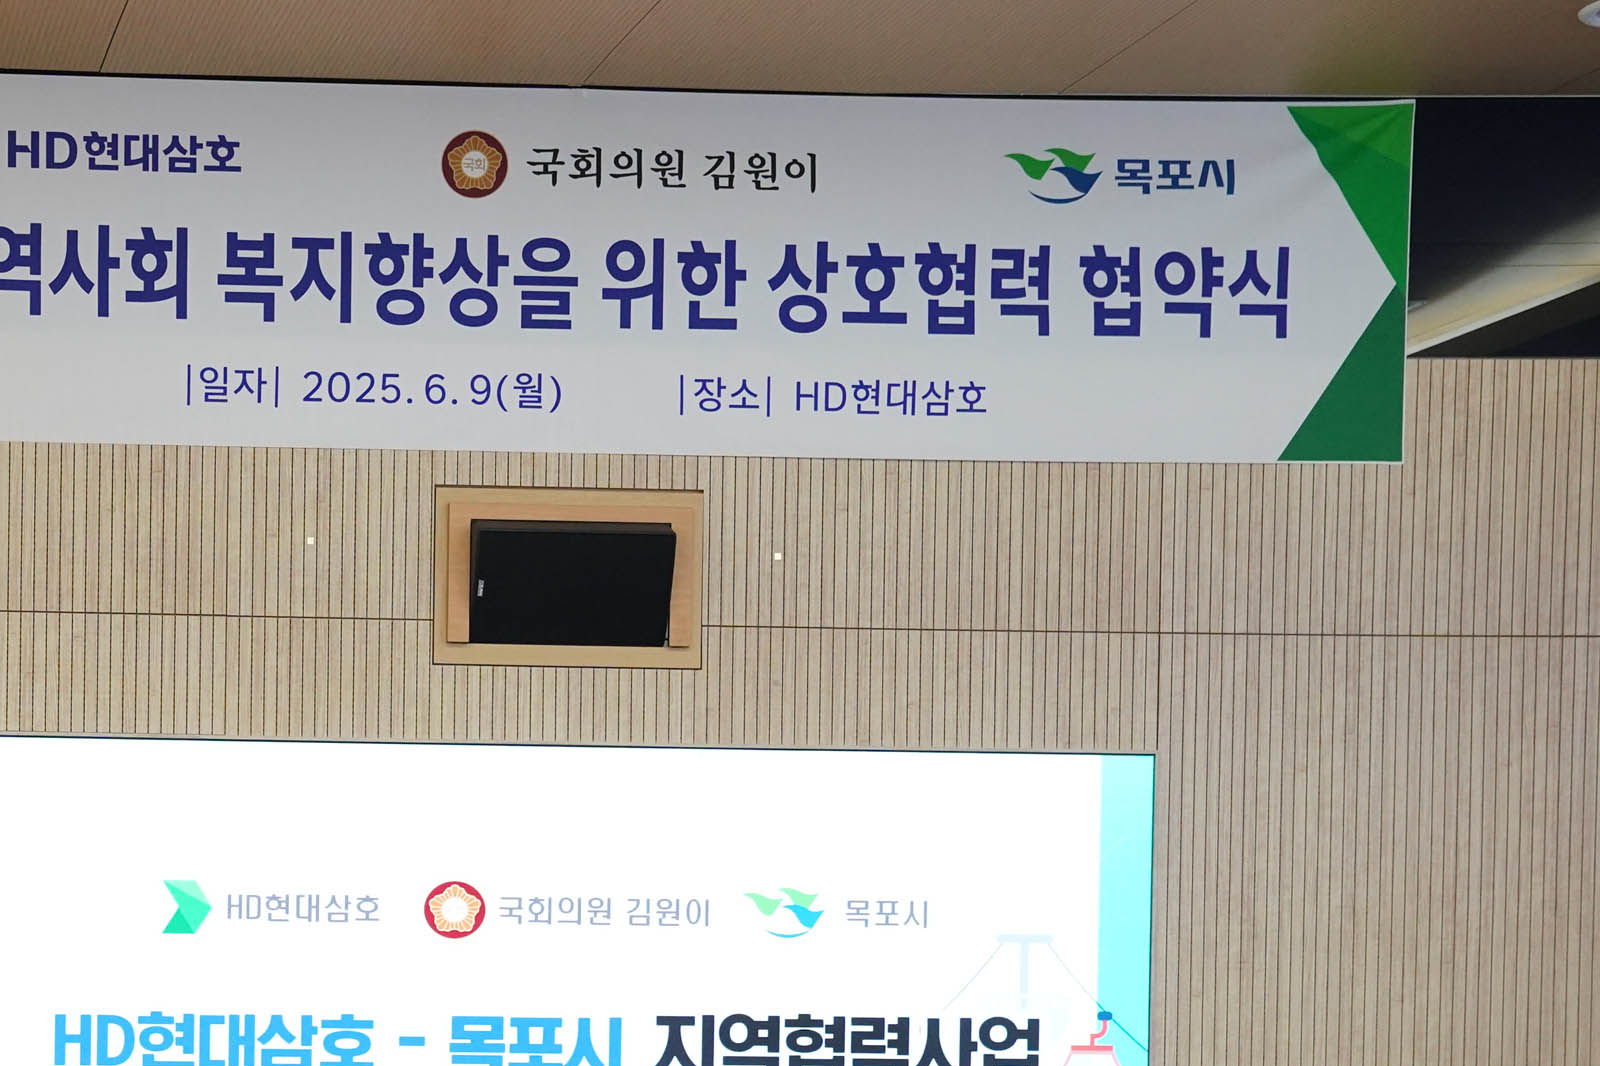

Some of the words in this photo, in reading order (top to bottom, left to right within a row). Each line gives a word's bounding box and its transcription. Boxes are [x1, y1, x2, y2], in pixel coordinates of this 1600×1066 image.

[7, 130, 242, 174] HD현대삼호
[526, 146, 687, 190] 국회의원
[702, 150, 817, 194] 김원이
[1114, 158, 1236, 196] 목포시
[217, 230, 579, 330] 복지향상을
[601, 237, 747, 331] 위한
[767, 240, 1051, 337] 상호협력
[1079, 244, 1290, 339] 협약식
[795, 379, 987, 417] HD현대삼호
[227, 894, 380, 923] HD현대삼호
[499, 896, 612, 926] 국회의원
[626, 898, 710, 927] 김원이
[845, 900, 928, 929] 목포시
